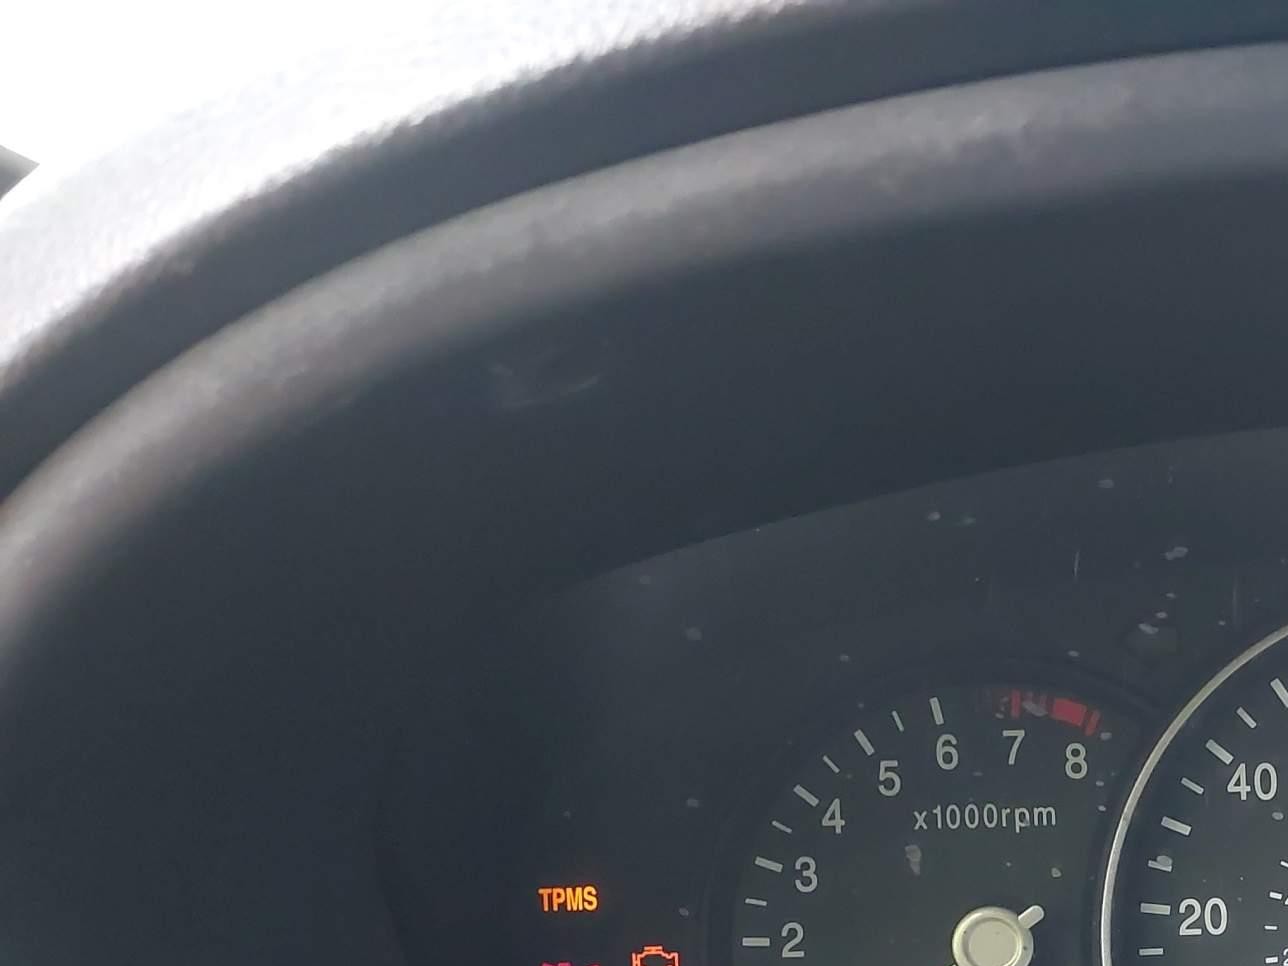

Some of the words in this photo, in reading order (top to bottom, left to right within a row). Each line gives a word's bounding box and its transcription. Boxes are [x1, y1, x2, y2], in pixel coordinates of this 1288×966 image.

[935, 734, 958, 770] 6
[1002, 730, 1025, 765] 7
[1064, 743, 1087, 779] 8
[878, 760, 900, 796] 5
[1227, 762, 1278, 800] 40
[822, 800, 845, 834] 4
[913, 803, 1057, 832] x1000rpm
[795, 857, 818, 892] 3
[538, 886, 598, 912] TPMS
[1178, 897, 1228, 936] 20
[781, 923, 805, 957] 2
